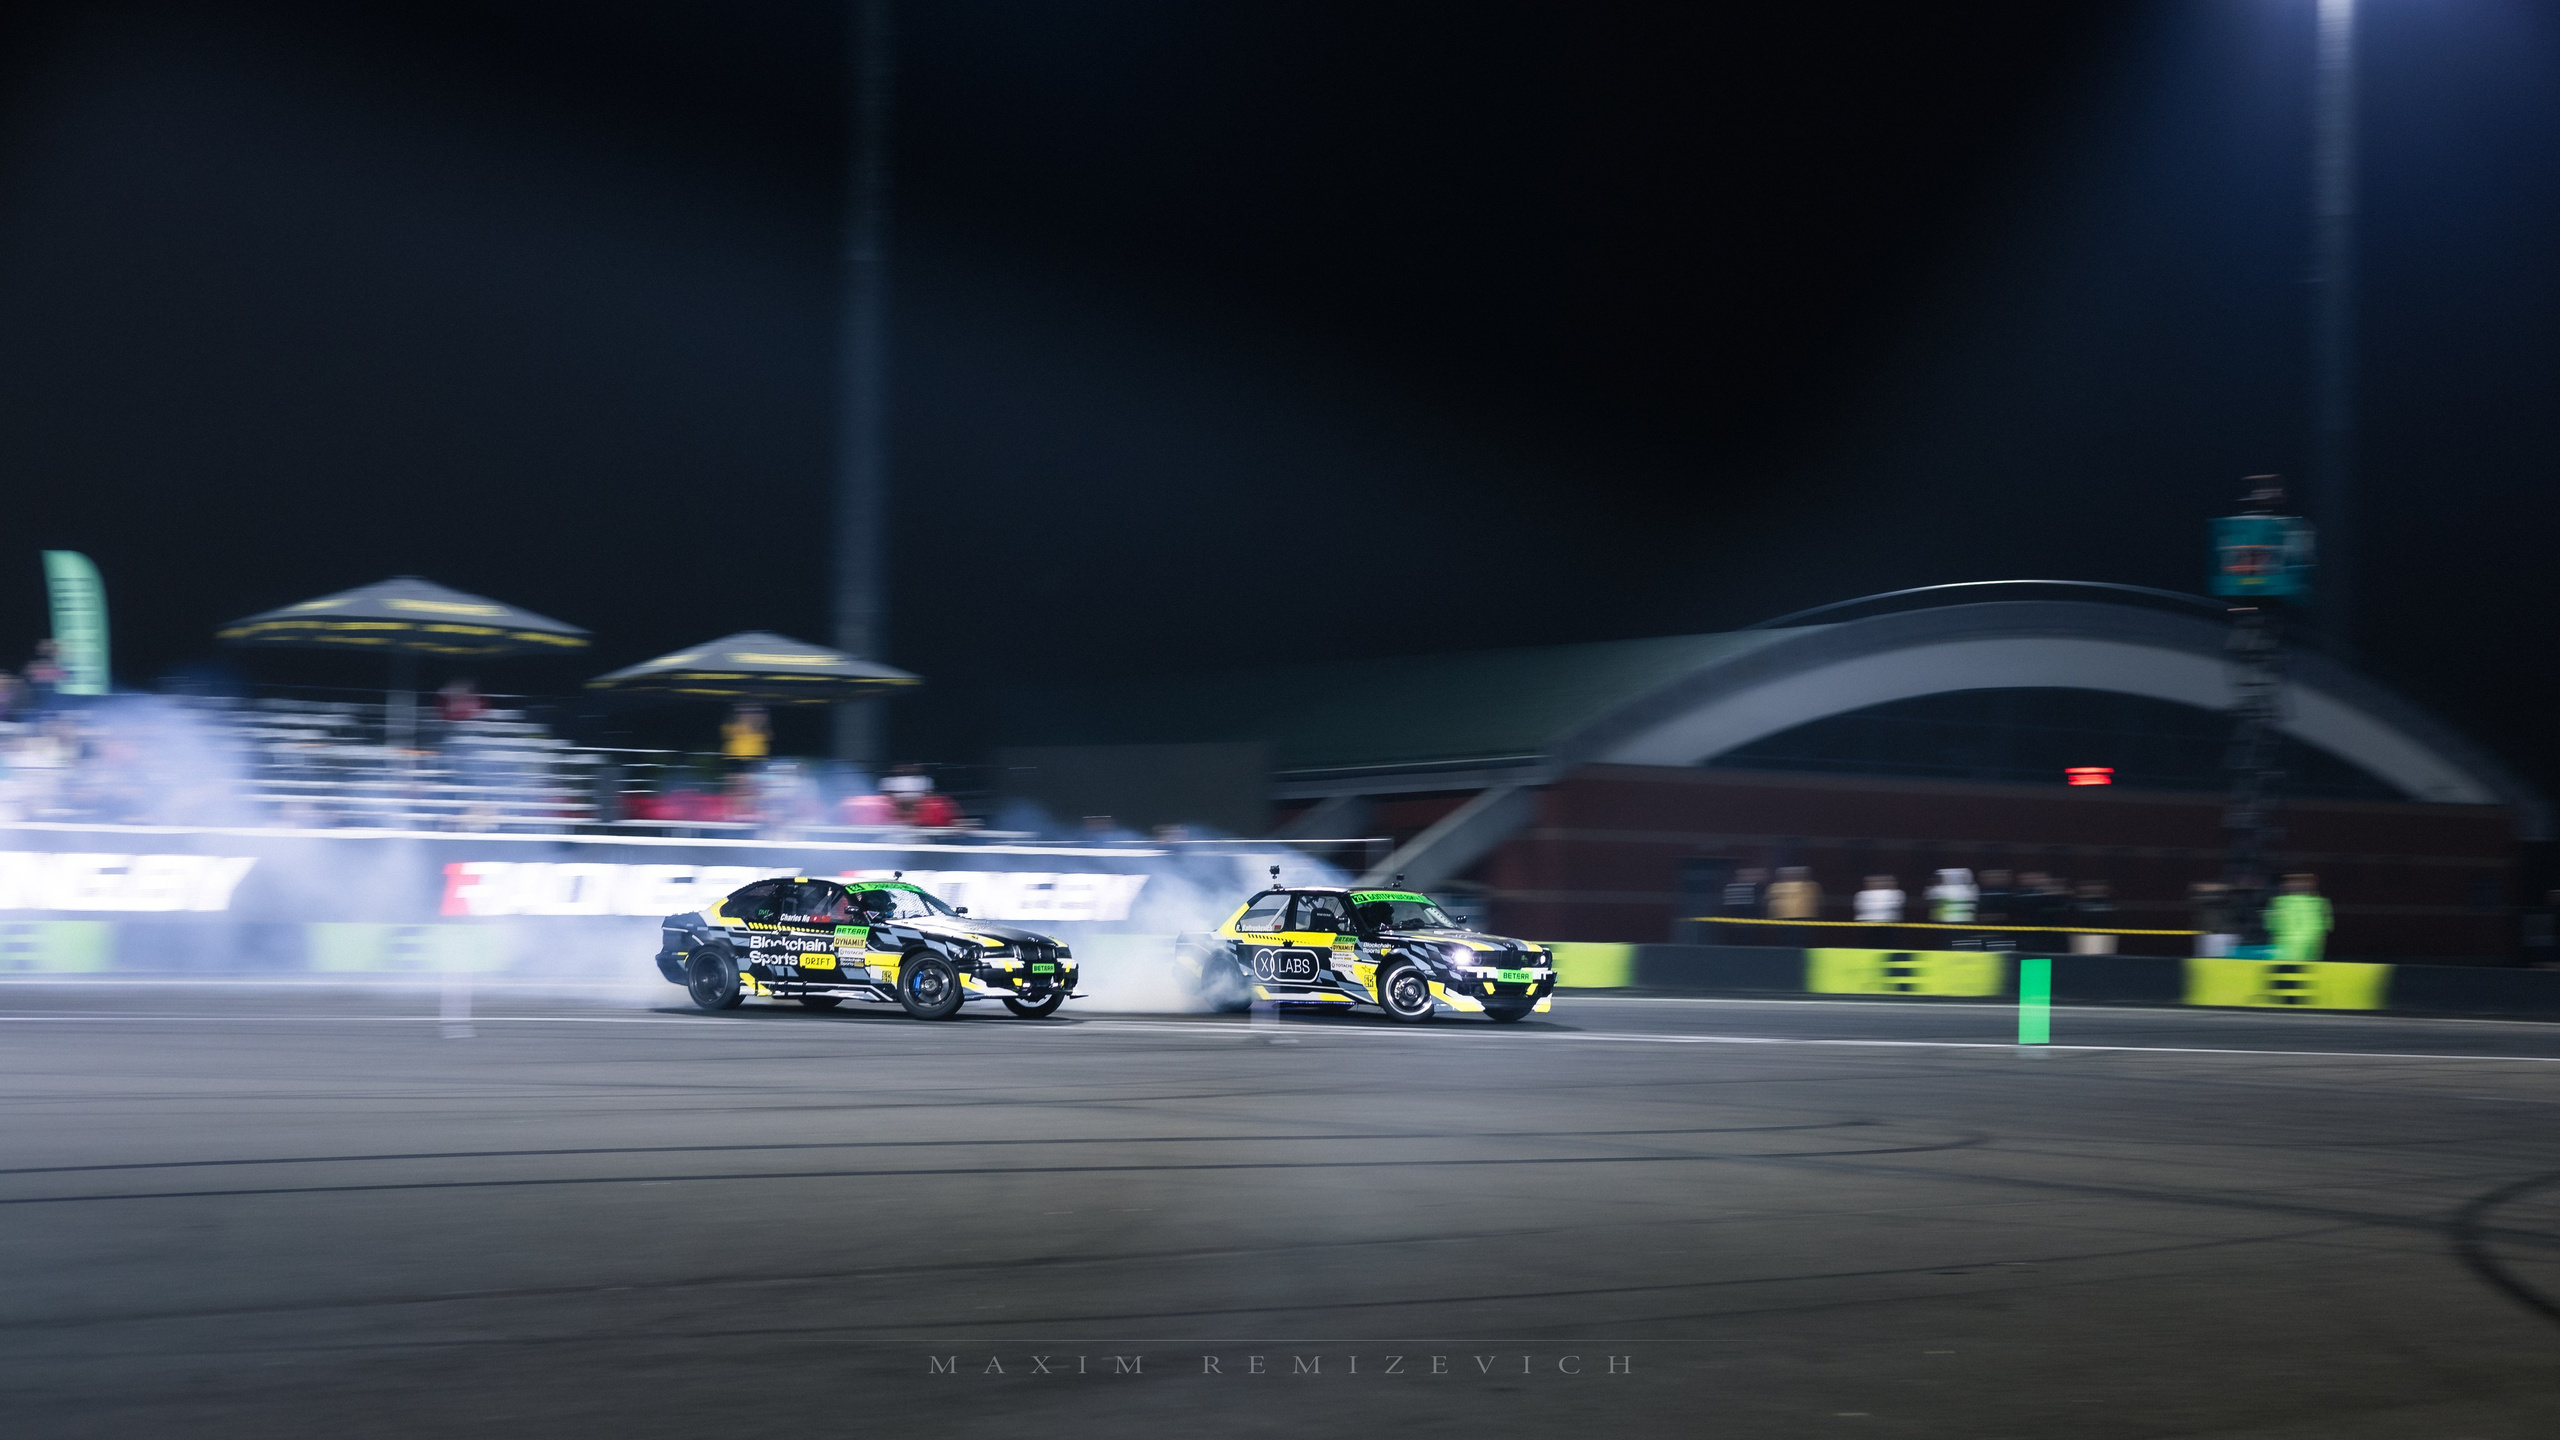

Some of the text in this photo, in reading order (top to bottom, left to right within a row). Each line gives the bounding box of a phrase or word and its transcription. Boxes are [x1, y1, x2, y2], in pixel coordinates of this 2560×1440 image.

[780, 913, 801, 922] Charles
[749, 935, 827, 952] Blockchain
[749, 950, 798, 967] Sports
[805, 957, 831, 966] DRIFT
[1278, 958, 1311, 974] LABS
[1503, 972, 1529, 980] BETERA
